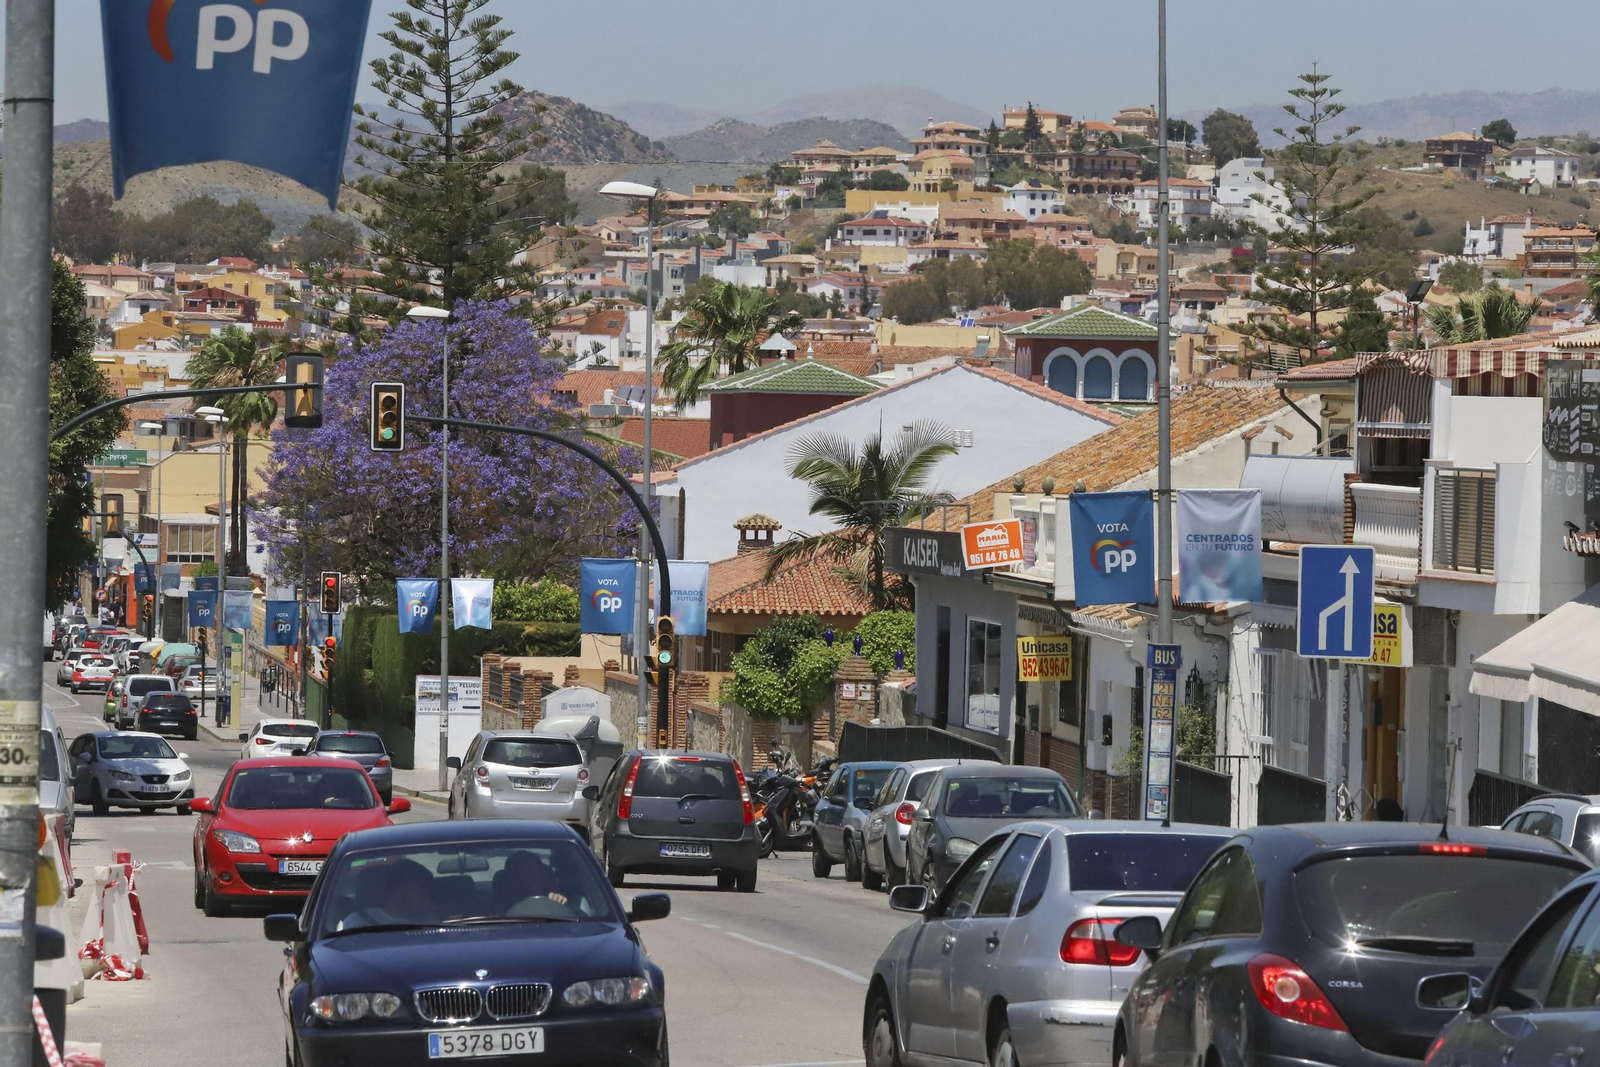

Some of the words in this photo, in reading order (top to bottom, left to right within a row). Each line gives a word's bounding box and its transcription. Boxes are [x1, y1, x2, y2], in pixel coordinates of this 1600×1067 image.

[1097, 523, 1129, 533] VOTA
[979, 534, 1007, 542] MARIA
[1186, 534, 1254, 543] CENTRADOS
[903, 537, 939, 568] KAISER
[1186, 543, 1199, 551] EN
[1200, 543, 1212, 551] TU
[1214, 543, 1254, 552] FUTURO
[970, 554, 983, 564] 951
[985, 551, 996, 562] 44
[998, 550, 1008, 560] 76
[1009, 548, 1020, 559] 48
[1104, 549, 1137, 574] pp
[598, 578, 619, 586] VOTA
[600, 596, 623, 612] pp
[1021, 640, 1068, 654] Unicasa
[1154, 650, 1175, 664] BUS
[1380, 648, 1391, 663] 47
[1022, 657, 1038, 677] 952
[1038, 657, 1049, 676] 43
[1049, 657, 1060, 676] 96
[1060, 657, 1070, 676] 47
[1158, 684, 1171, 694] 21
[1155, 708, 1169, 719] 62
[667, 845, 689, 853] 0755
[287, 862, 311, 872] 6544
[1328, 980, 1363, 988] CORSA
[443, 1033, 493, 1054] 5378
[501, 1030, 538, 1051] DGY
